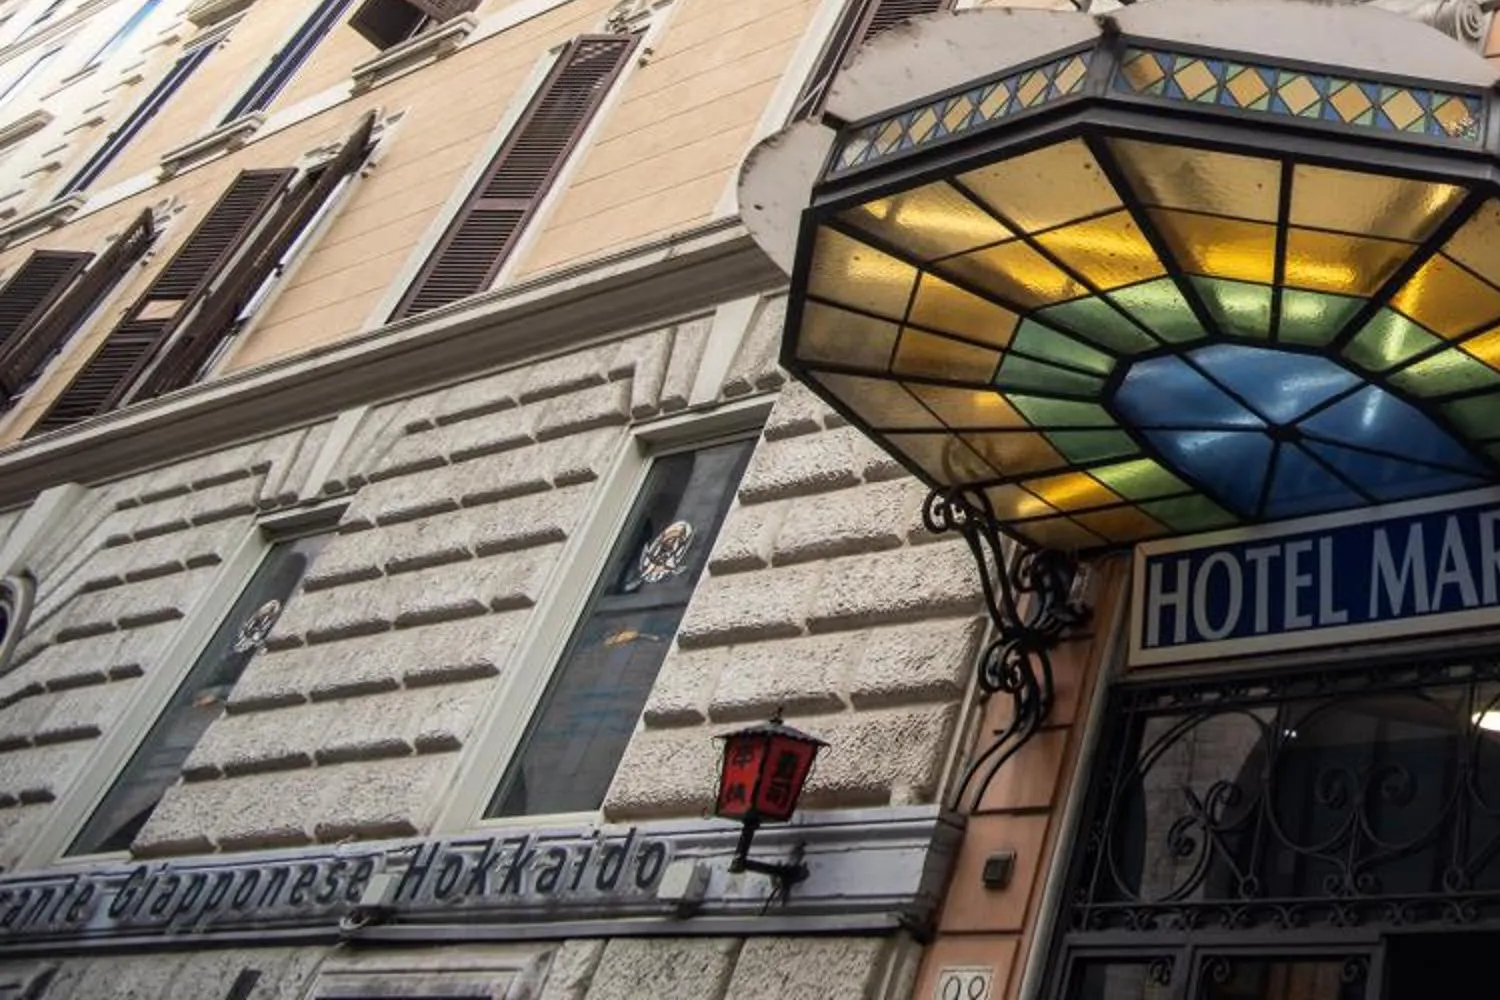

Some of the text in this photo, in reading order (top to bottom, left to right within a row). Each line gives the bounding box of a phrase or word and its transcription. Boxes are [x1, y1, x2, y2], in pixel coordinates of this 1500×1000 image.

[1146, 535, 1348, 648] HOTEL
[109, 855, 374, 930] Giapponese
[394, 827, 667, 901] Hokkaido
